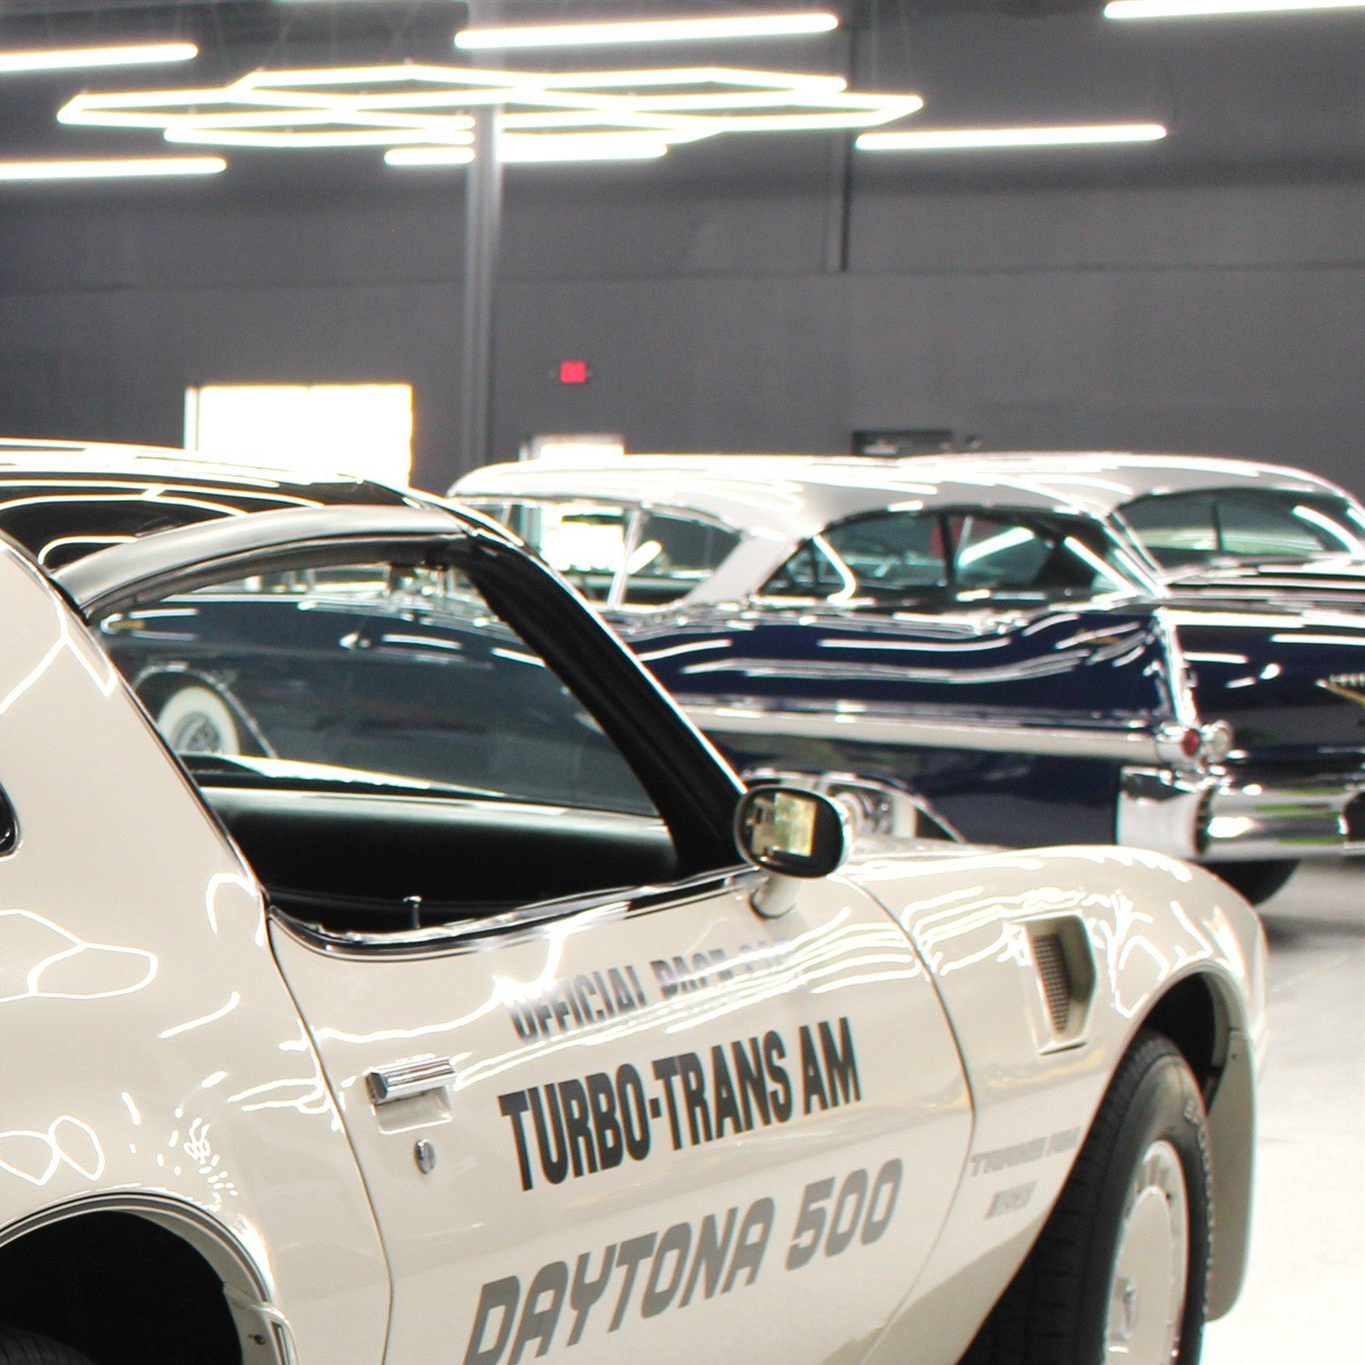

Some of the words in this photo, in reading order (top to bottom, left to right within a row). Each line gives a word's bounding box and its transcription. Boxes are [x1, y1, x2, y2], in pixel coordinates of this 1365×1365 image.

[498, 1030, 793, 1192] TURBO-TRANS
[799, 1016, 862, 1117] AM
[784, 1157, 904, 1272] 500
